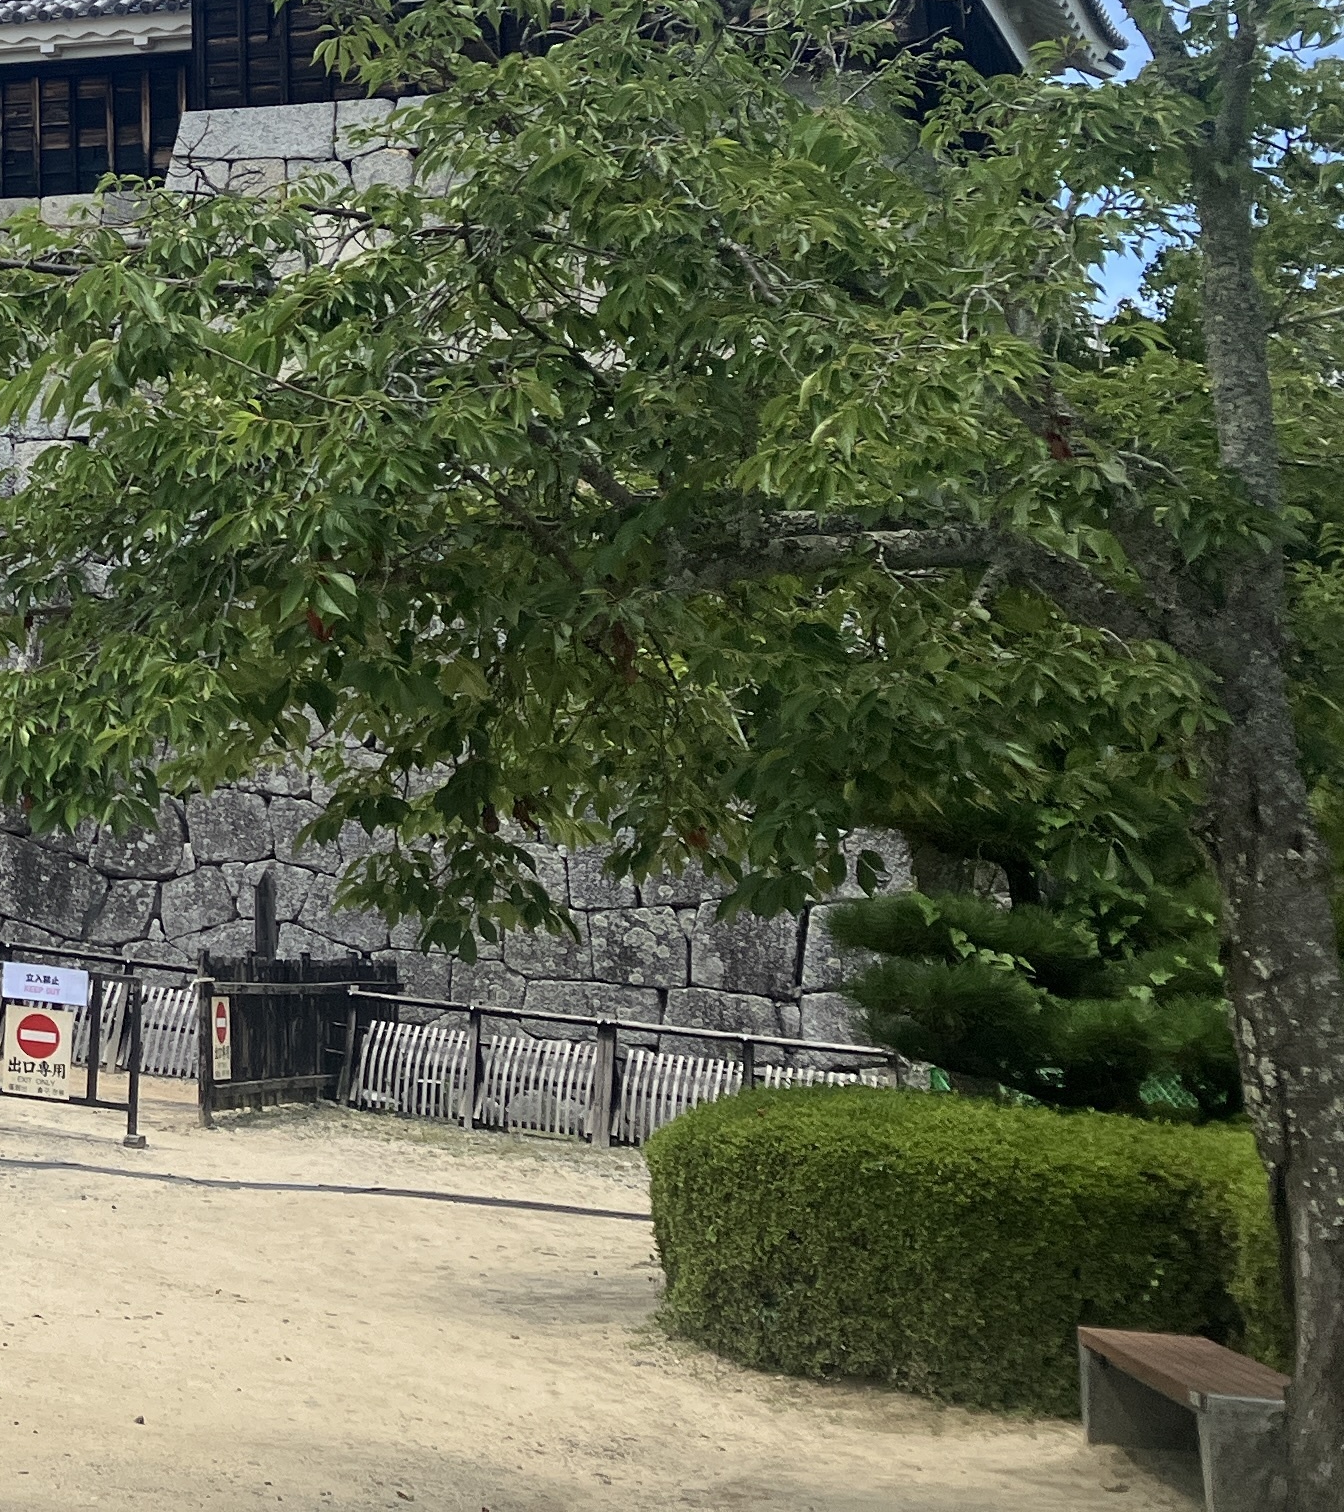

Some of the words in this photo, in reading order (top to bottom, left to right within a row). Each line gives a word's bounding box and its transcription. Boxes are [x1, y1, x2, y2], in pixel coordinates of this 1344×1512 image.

[25, 972, 60, 986] 立入禁止
[8, 1056, 66, 1080] 出口専用
